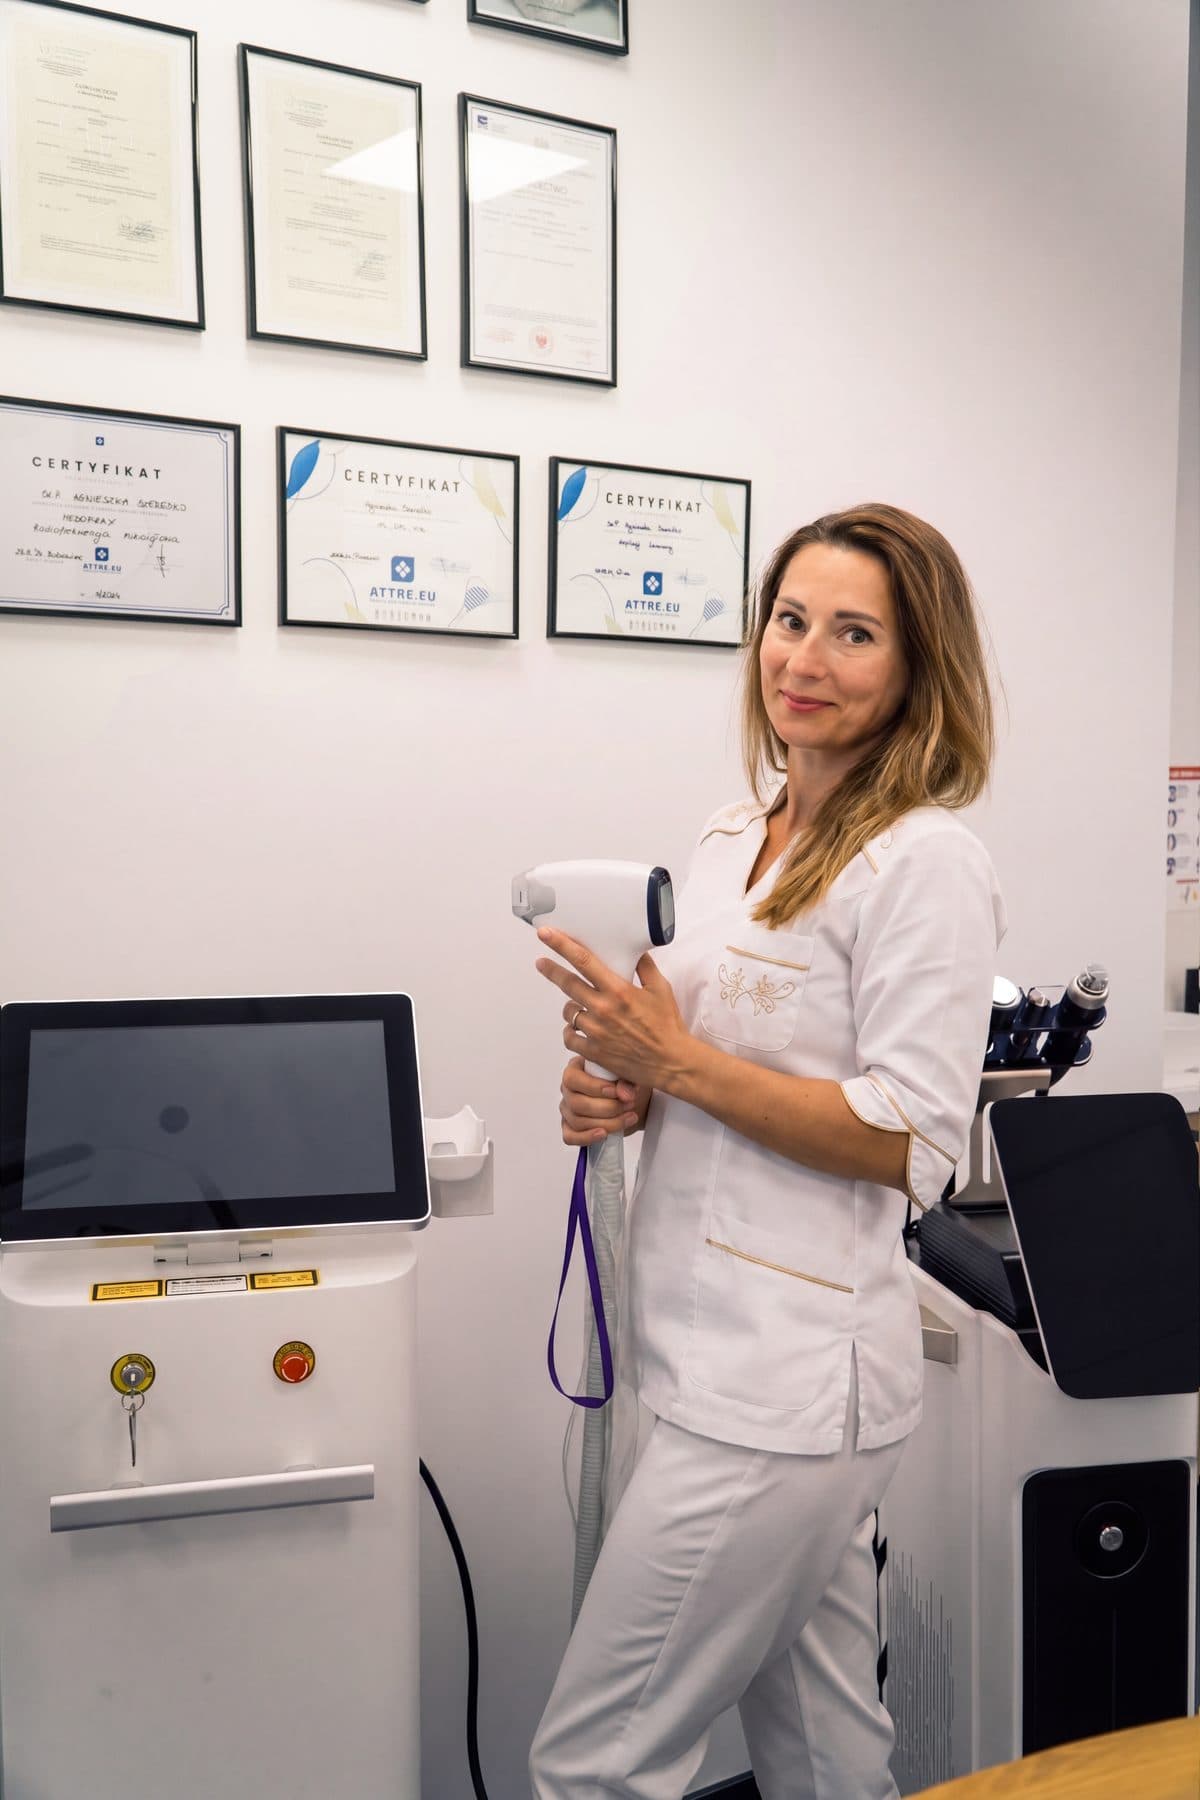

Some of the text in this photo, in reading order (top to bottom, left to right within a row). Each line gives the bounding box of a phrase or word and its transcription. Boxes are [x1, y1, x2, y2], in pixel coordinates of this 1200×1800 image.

[32, 456, 162, 480] CERTYFIKAT
[344, 469, 461, 493] CERTYFIKAT
[73, 493, 129, 506] AGNIESZKA
[606, 492, 702, 513] CERTYFIKAT
[83, 562, 122, 573] ATTRE.EU
[369, 586, 436, 602] ATTRE.EU
[625, 599, 680, 613] ATTRE.EU
